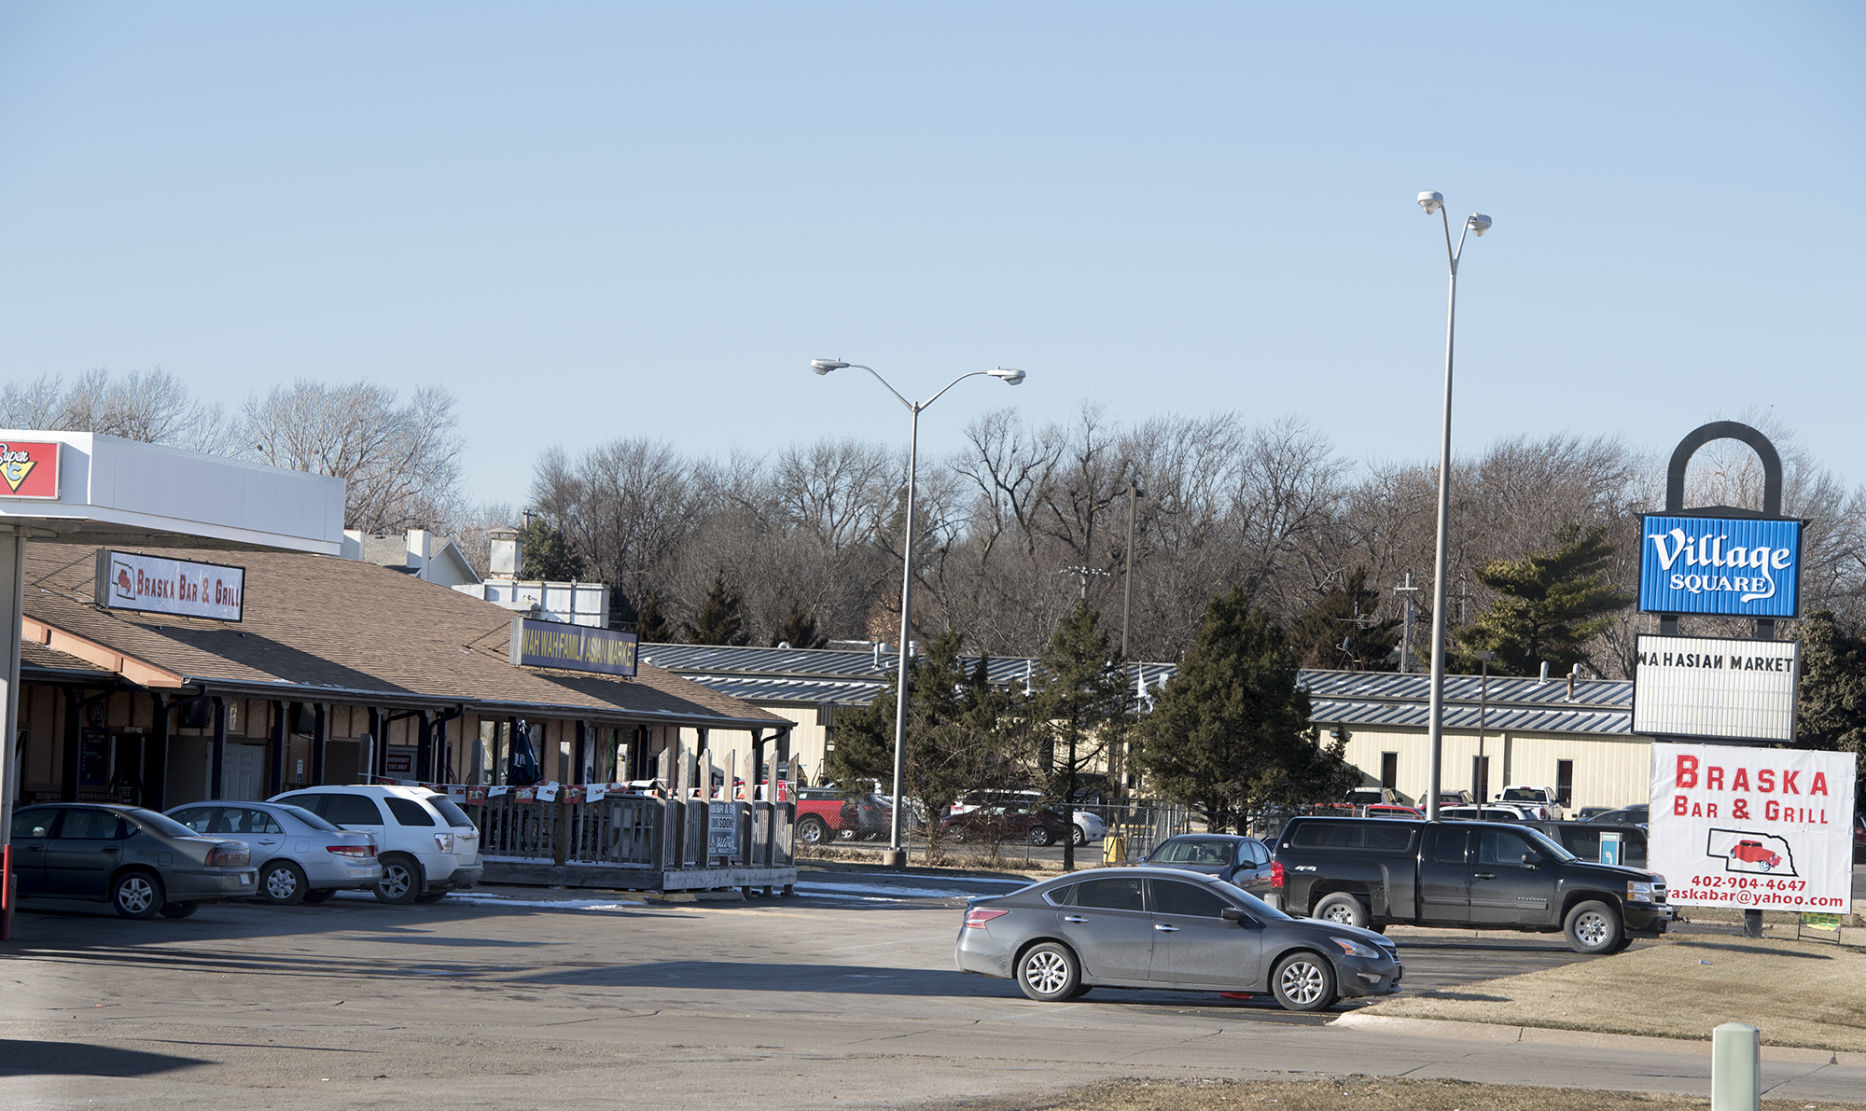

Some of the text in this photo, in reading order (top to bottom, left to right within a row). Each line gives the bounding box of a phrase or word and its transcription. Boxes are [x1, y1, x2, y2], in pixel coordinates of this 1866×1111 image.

[7, 465, 22, 481] C
[1648, 528, 1791, 603] Village
[137, 568, 239, 607] BRASKA BAR & GRILL
[1669, 574, 1767, 594] SQUARE
[521, 628, 637, 668] WAH WAH FAMILY ASIAN MARKET
[1730, 655, 1793, 673] MARKET
[1676, 755, 1829, 797] BRASKA
[1673, 795, 1829, 824] BAR & GRILL
[1691, 875, 1806, 892] 402-904-4647
[1666, 888, 1843, 907] raskabar@yahoo.com
